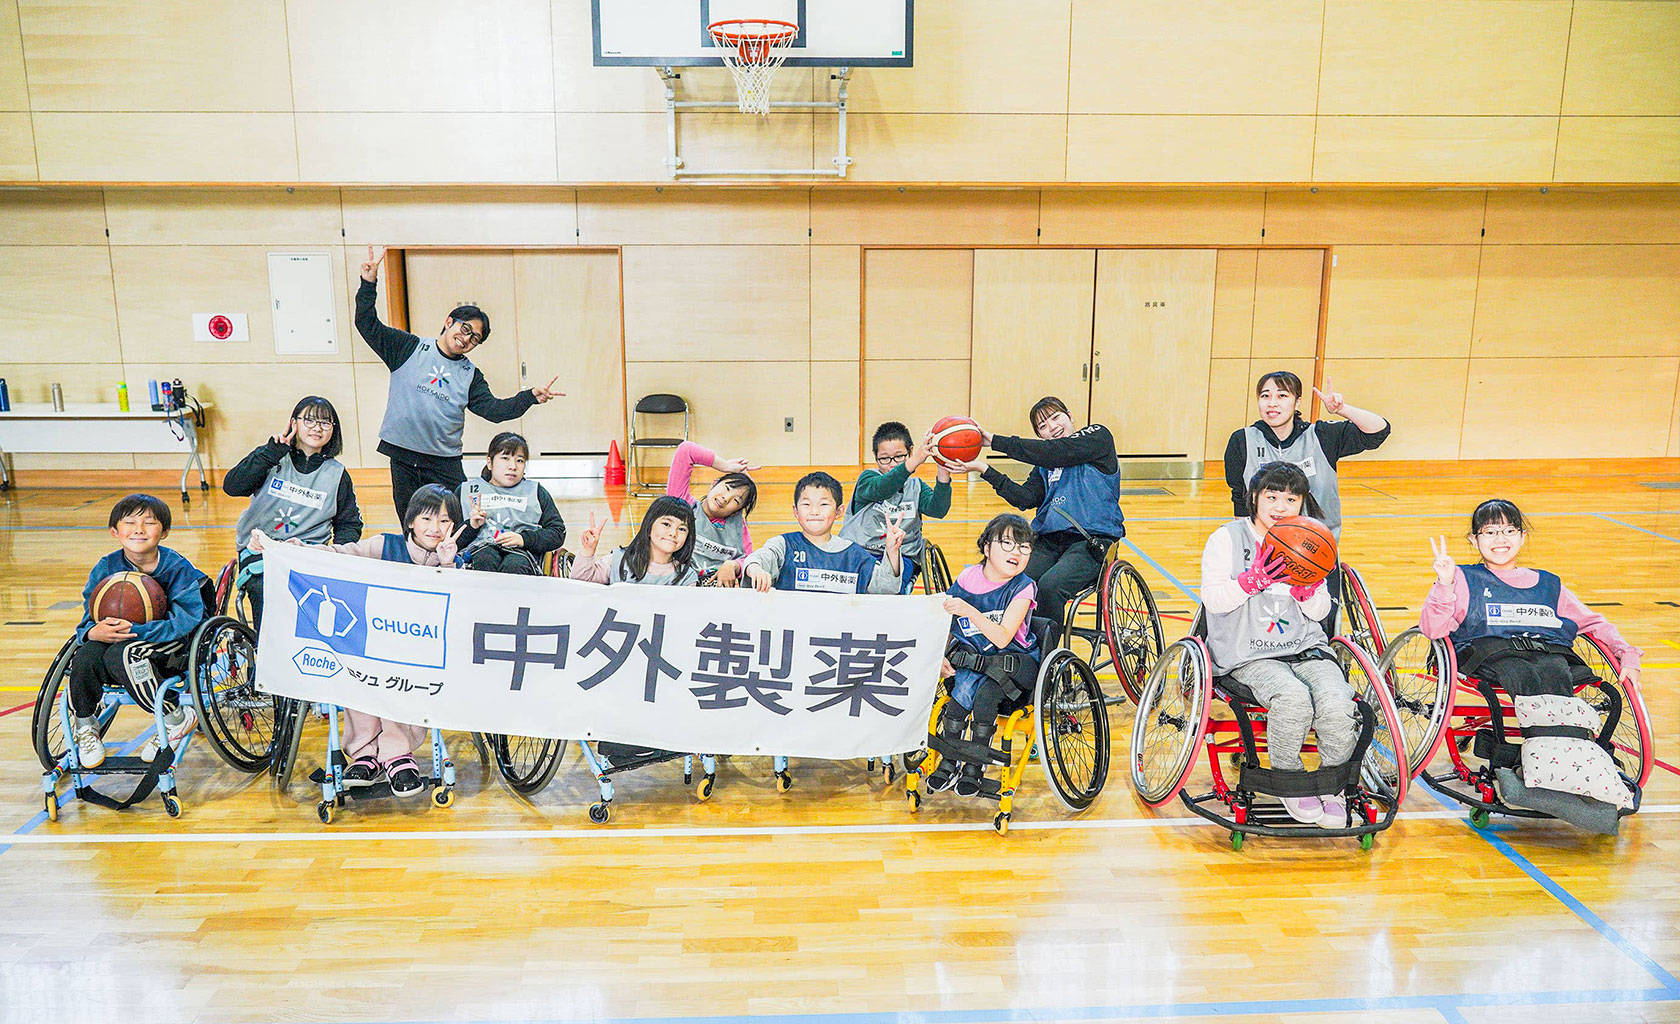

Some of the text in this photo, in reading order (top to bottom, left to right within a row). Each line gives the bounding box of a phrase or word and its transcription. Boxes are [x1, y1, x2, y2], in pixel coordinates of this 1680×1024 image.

[421, 342, 431, 352] 13
[1257, 446, 1266, 458] 11
[469, 484, 480, 493] 12
[793, 550, 806, 563] 20
[820, 572, 858, 585] 中外製薬
[371, 617, 439, 639] CHUGAI
[1249, 638, 1302, 649] HOKKAIDO
[302, 653, 337, 671] Roche
[471, 606, 917, 718] 中外製薬
[385, 676, 445, 696] グループ
